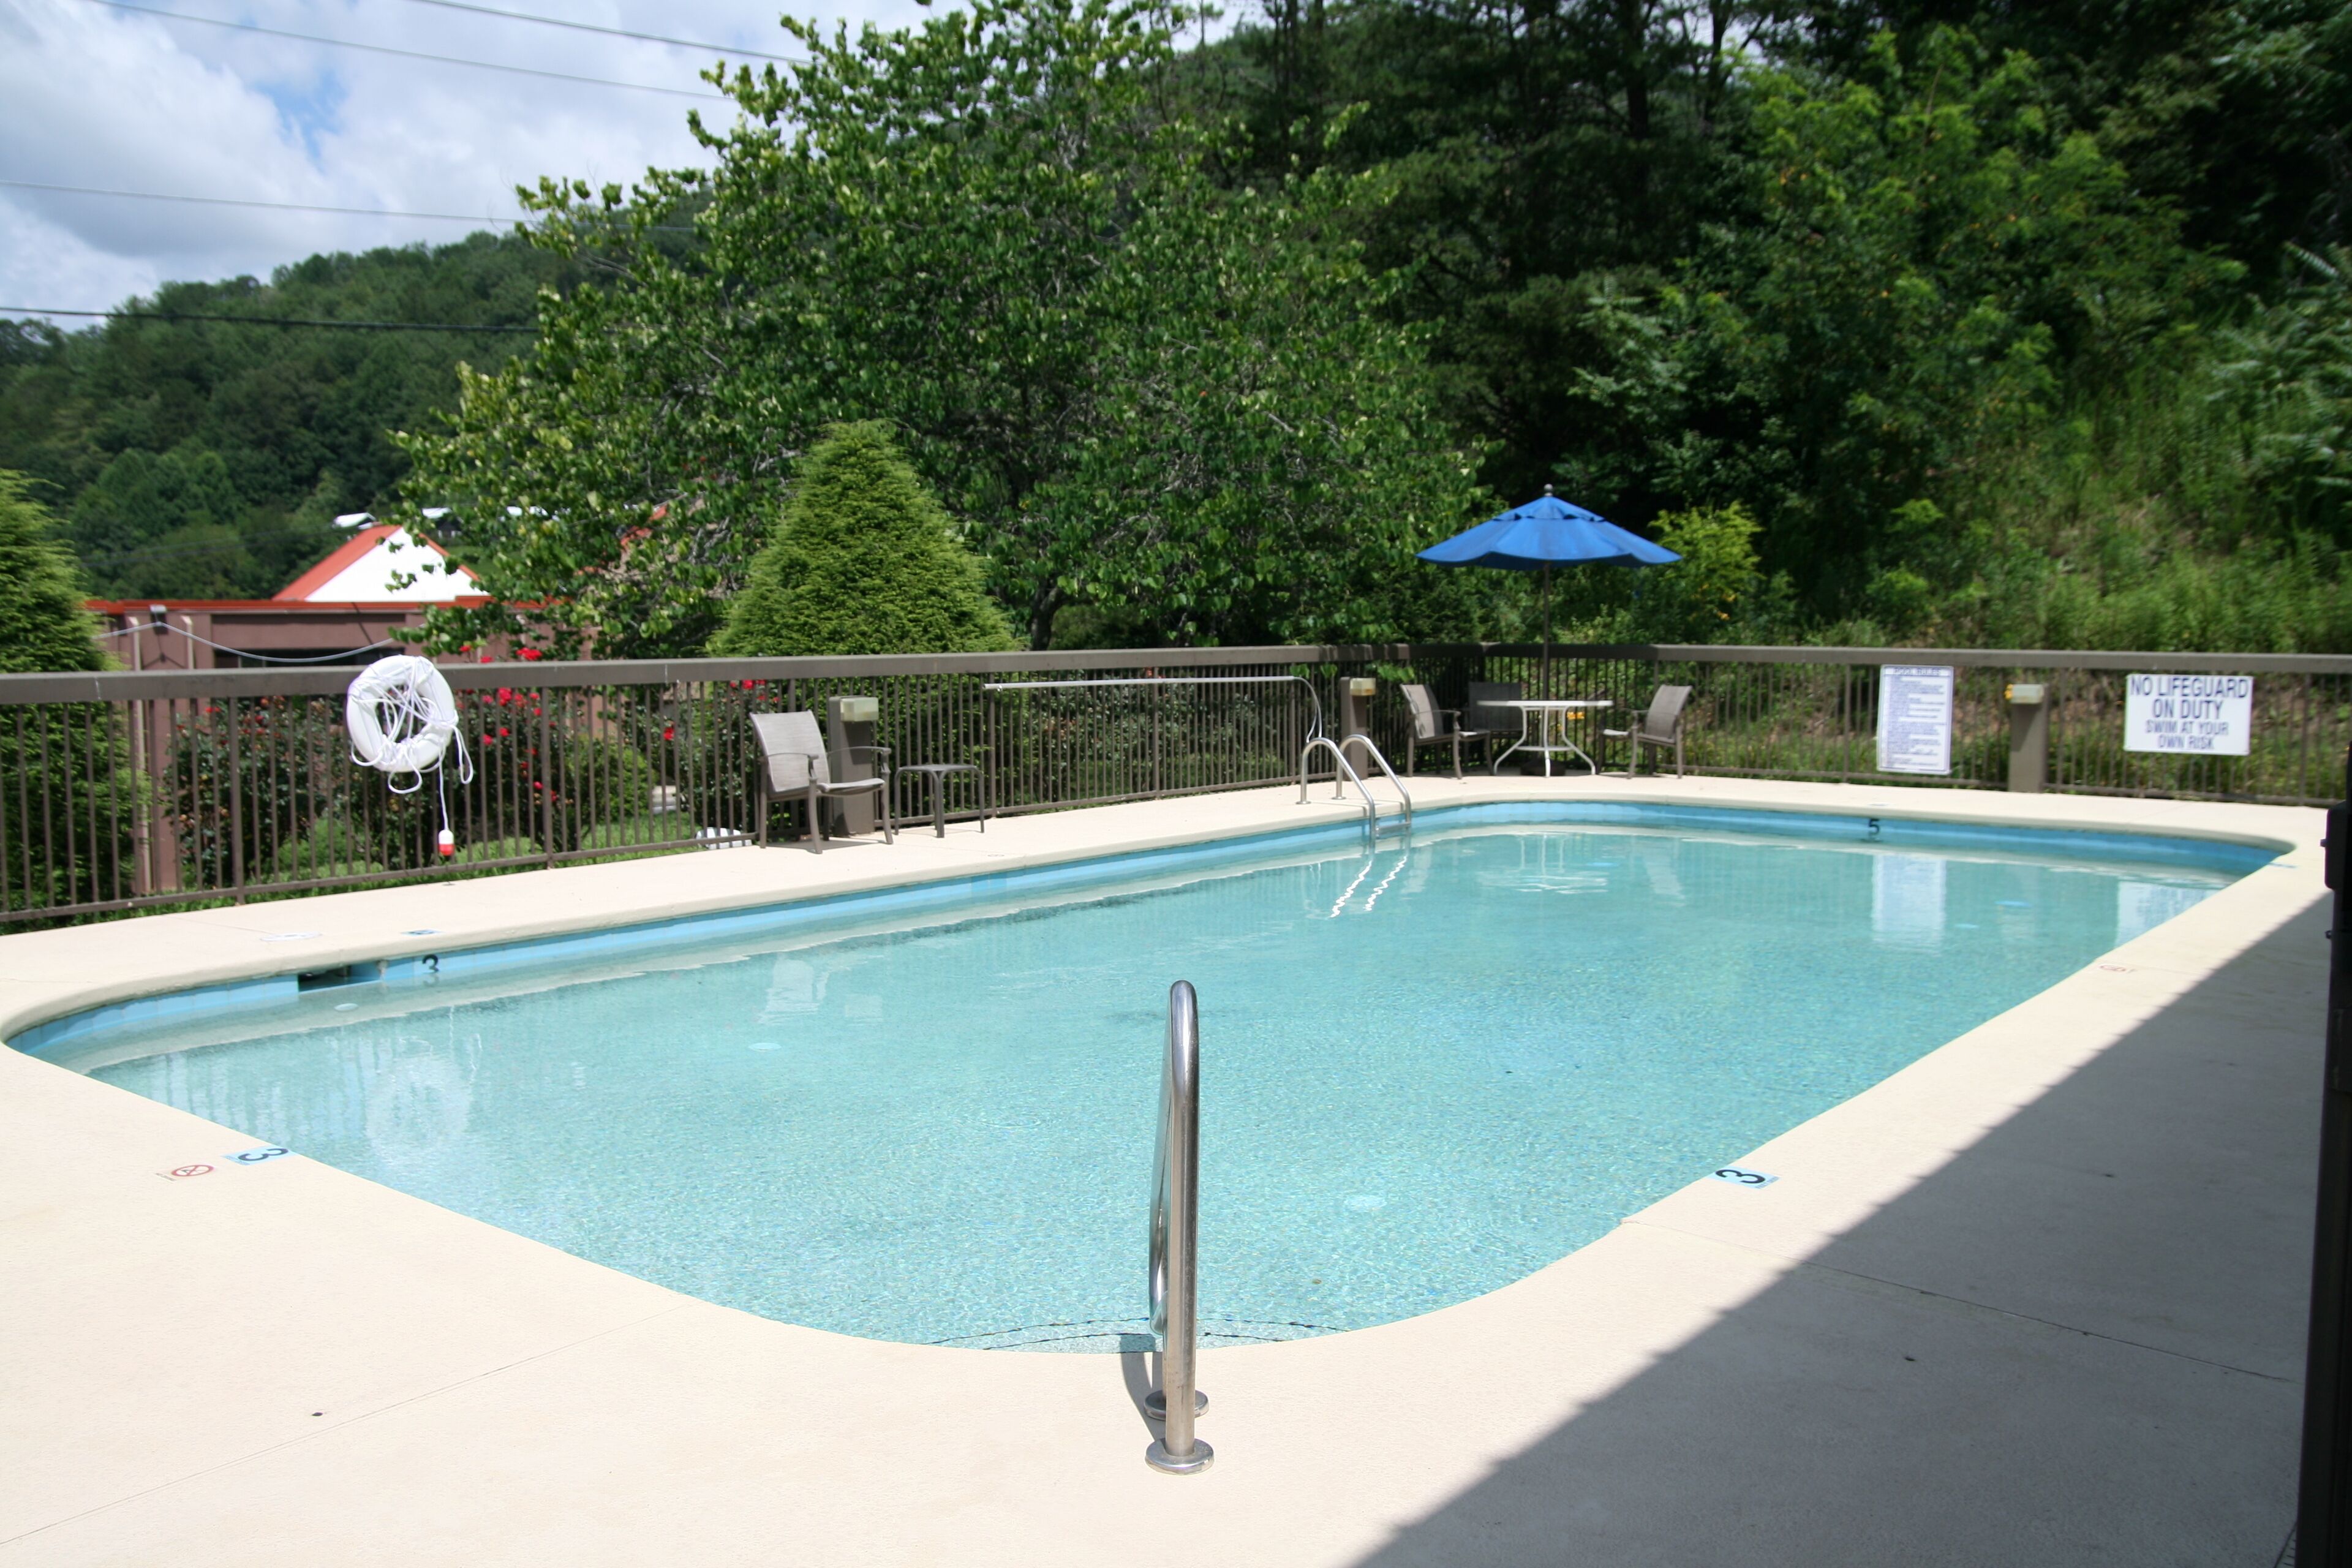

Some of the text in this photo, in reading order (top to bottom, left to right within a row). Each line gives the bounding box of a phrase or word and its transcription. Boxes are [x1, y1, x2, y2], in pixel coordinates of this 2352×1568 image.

[2131, 676, 2248, 698] NO LIFEGUARD
[2152, 698, 2223, 719] ON DUTY
[2146, 719, 2229, 735] SWIM AT YOUR
[2158, 734, 2214, 750] OWN RISK
[1868, 818, 1880, 835] 5
[237, 1148, 288, 1161] 3
[1715, 1169, 1766, 1184] 3
